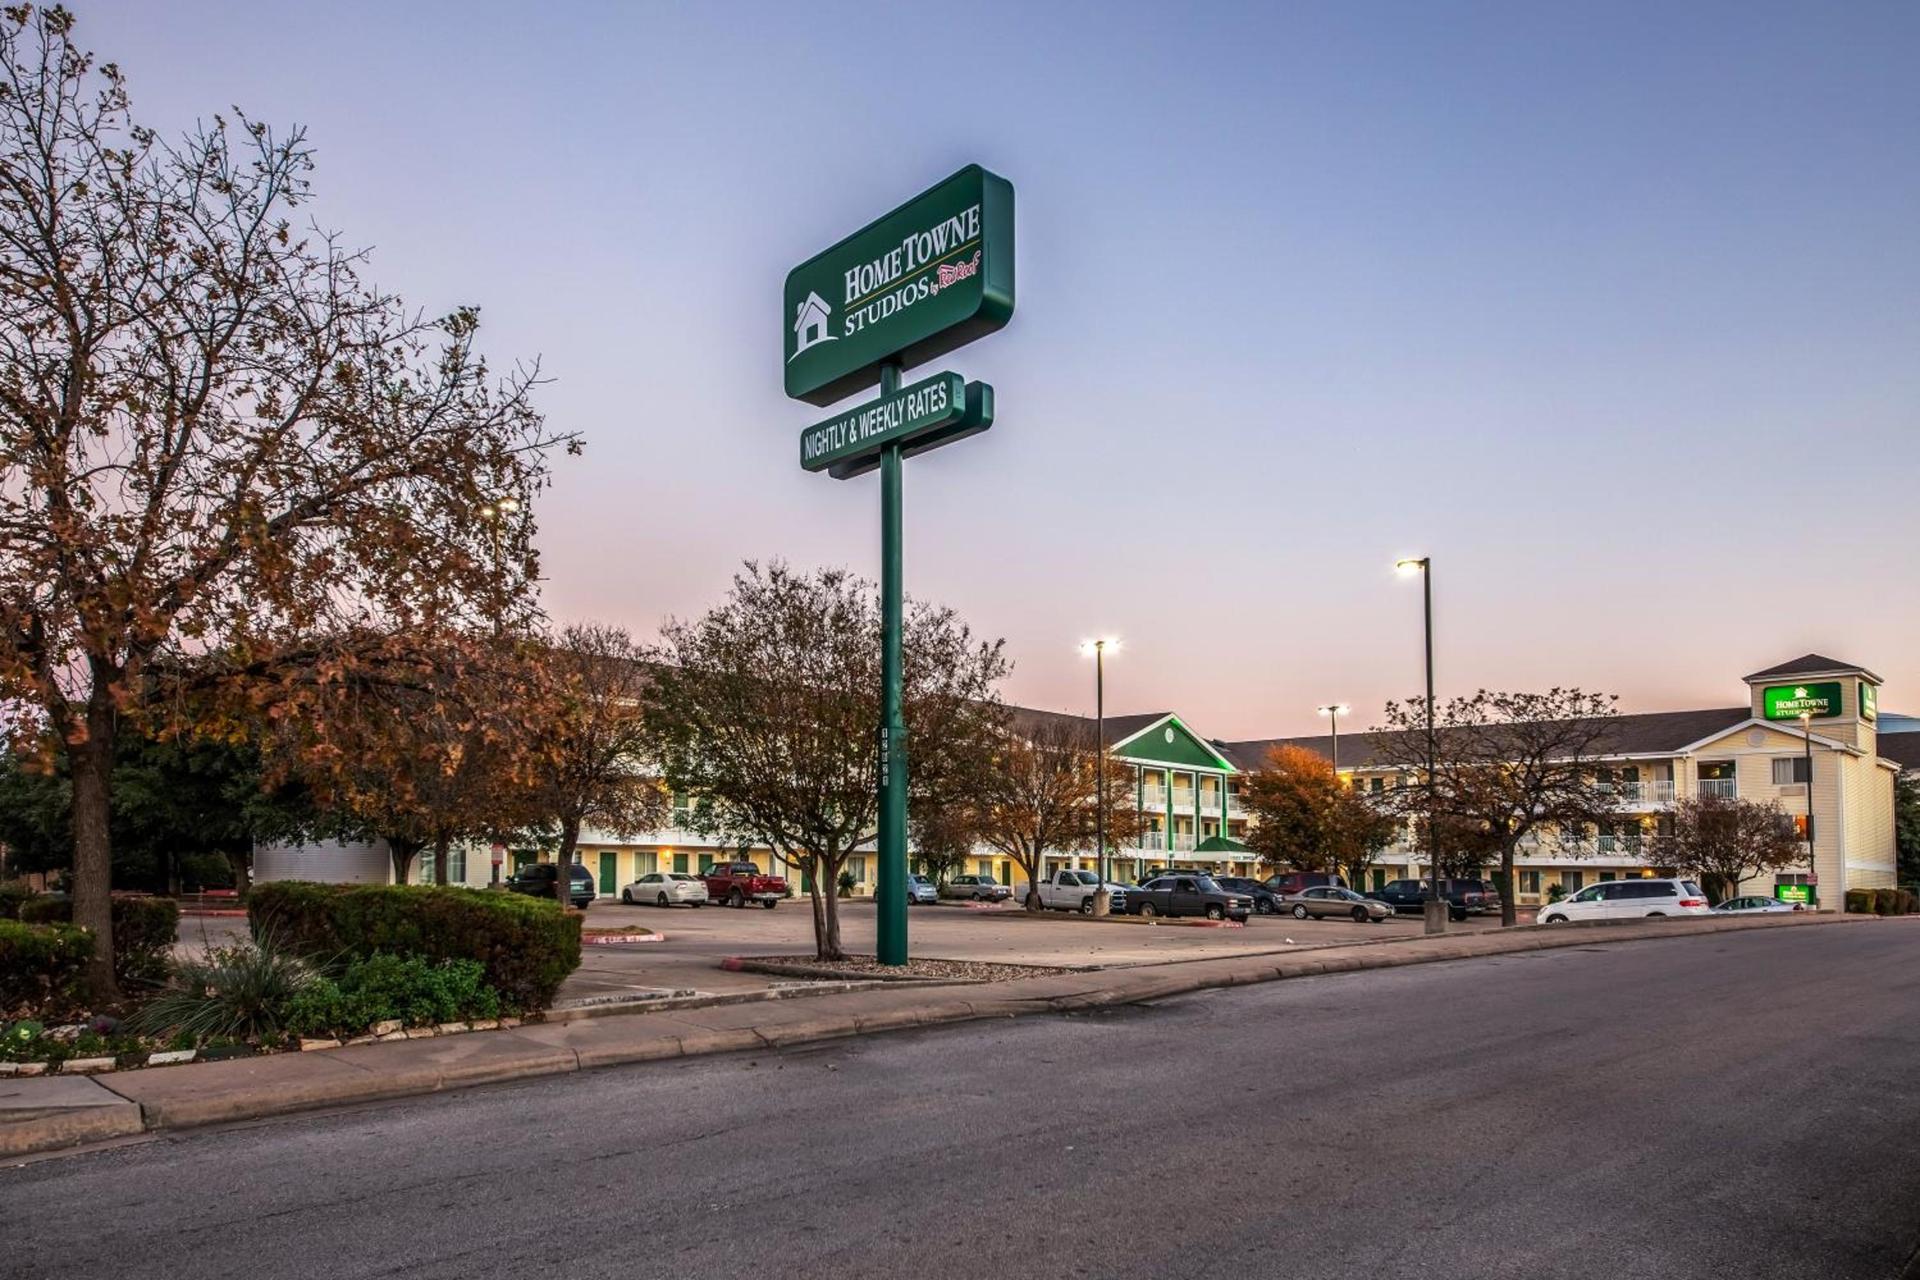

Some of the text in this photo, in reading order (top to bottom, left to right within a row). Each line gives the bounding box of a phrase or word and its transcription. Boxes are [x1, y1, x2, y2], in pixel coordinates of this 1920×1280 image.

[844, 275, 929, 336] STUDIOS
[804, 380, 947, 460] NIGHTLY & WEEKLY RATES
